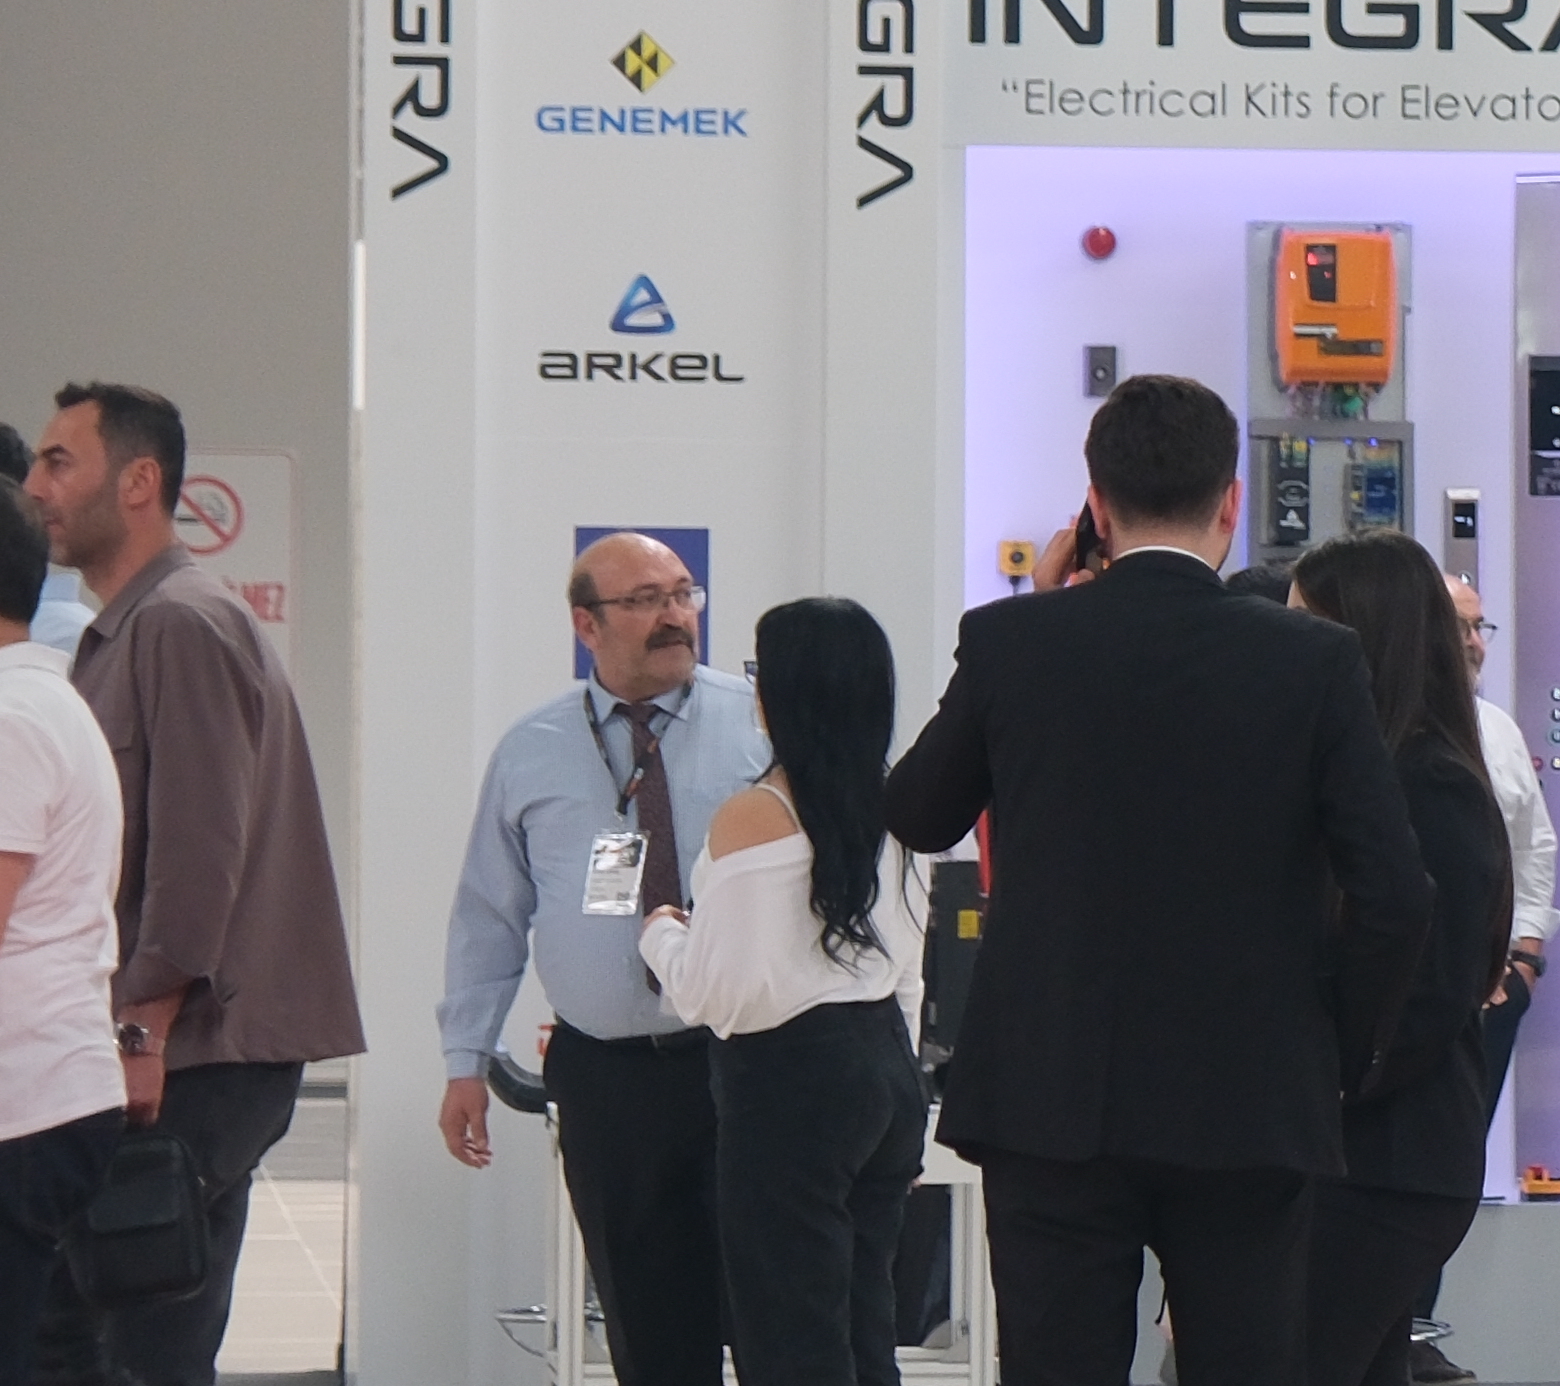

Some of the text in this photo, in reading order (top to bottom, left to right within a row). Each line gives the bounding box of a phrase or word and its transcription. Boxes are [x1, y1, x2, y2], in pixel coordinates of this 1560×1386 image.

[1245, 82, 1311, 118] Kits
[1329, 83, 1384, 119] for
[537, 107, 746, 136] GENEMEK
